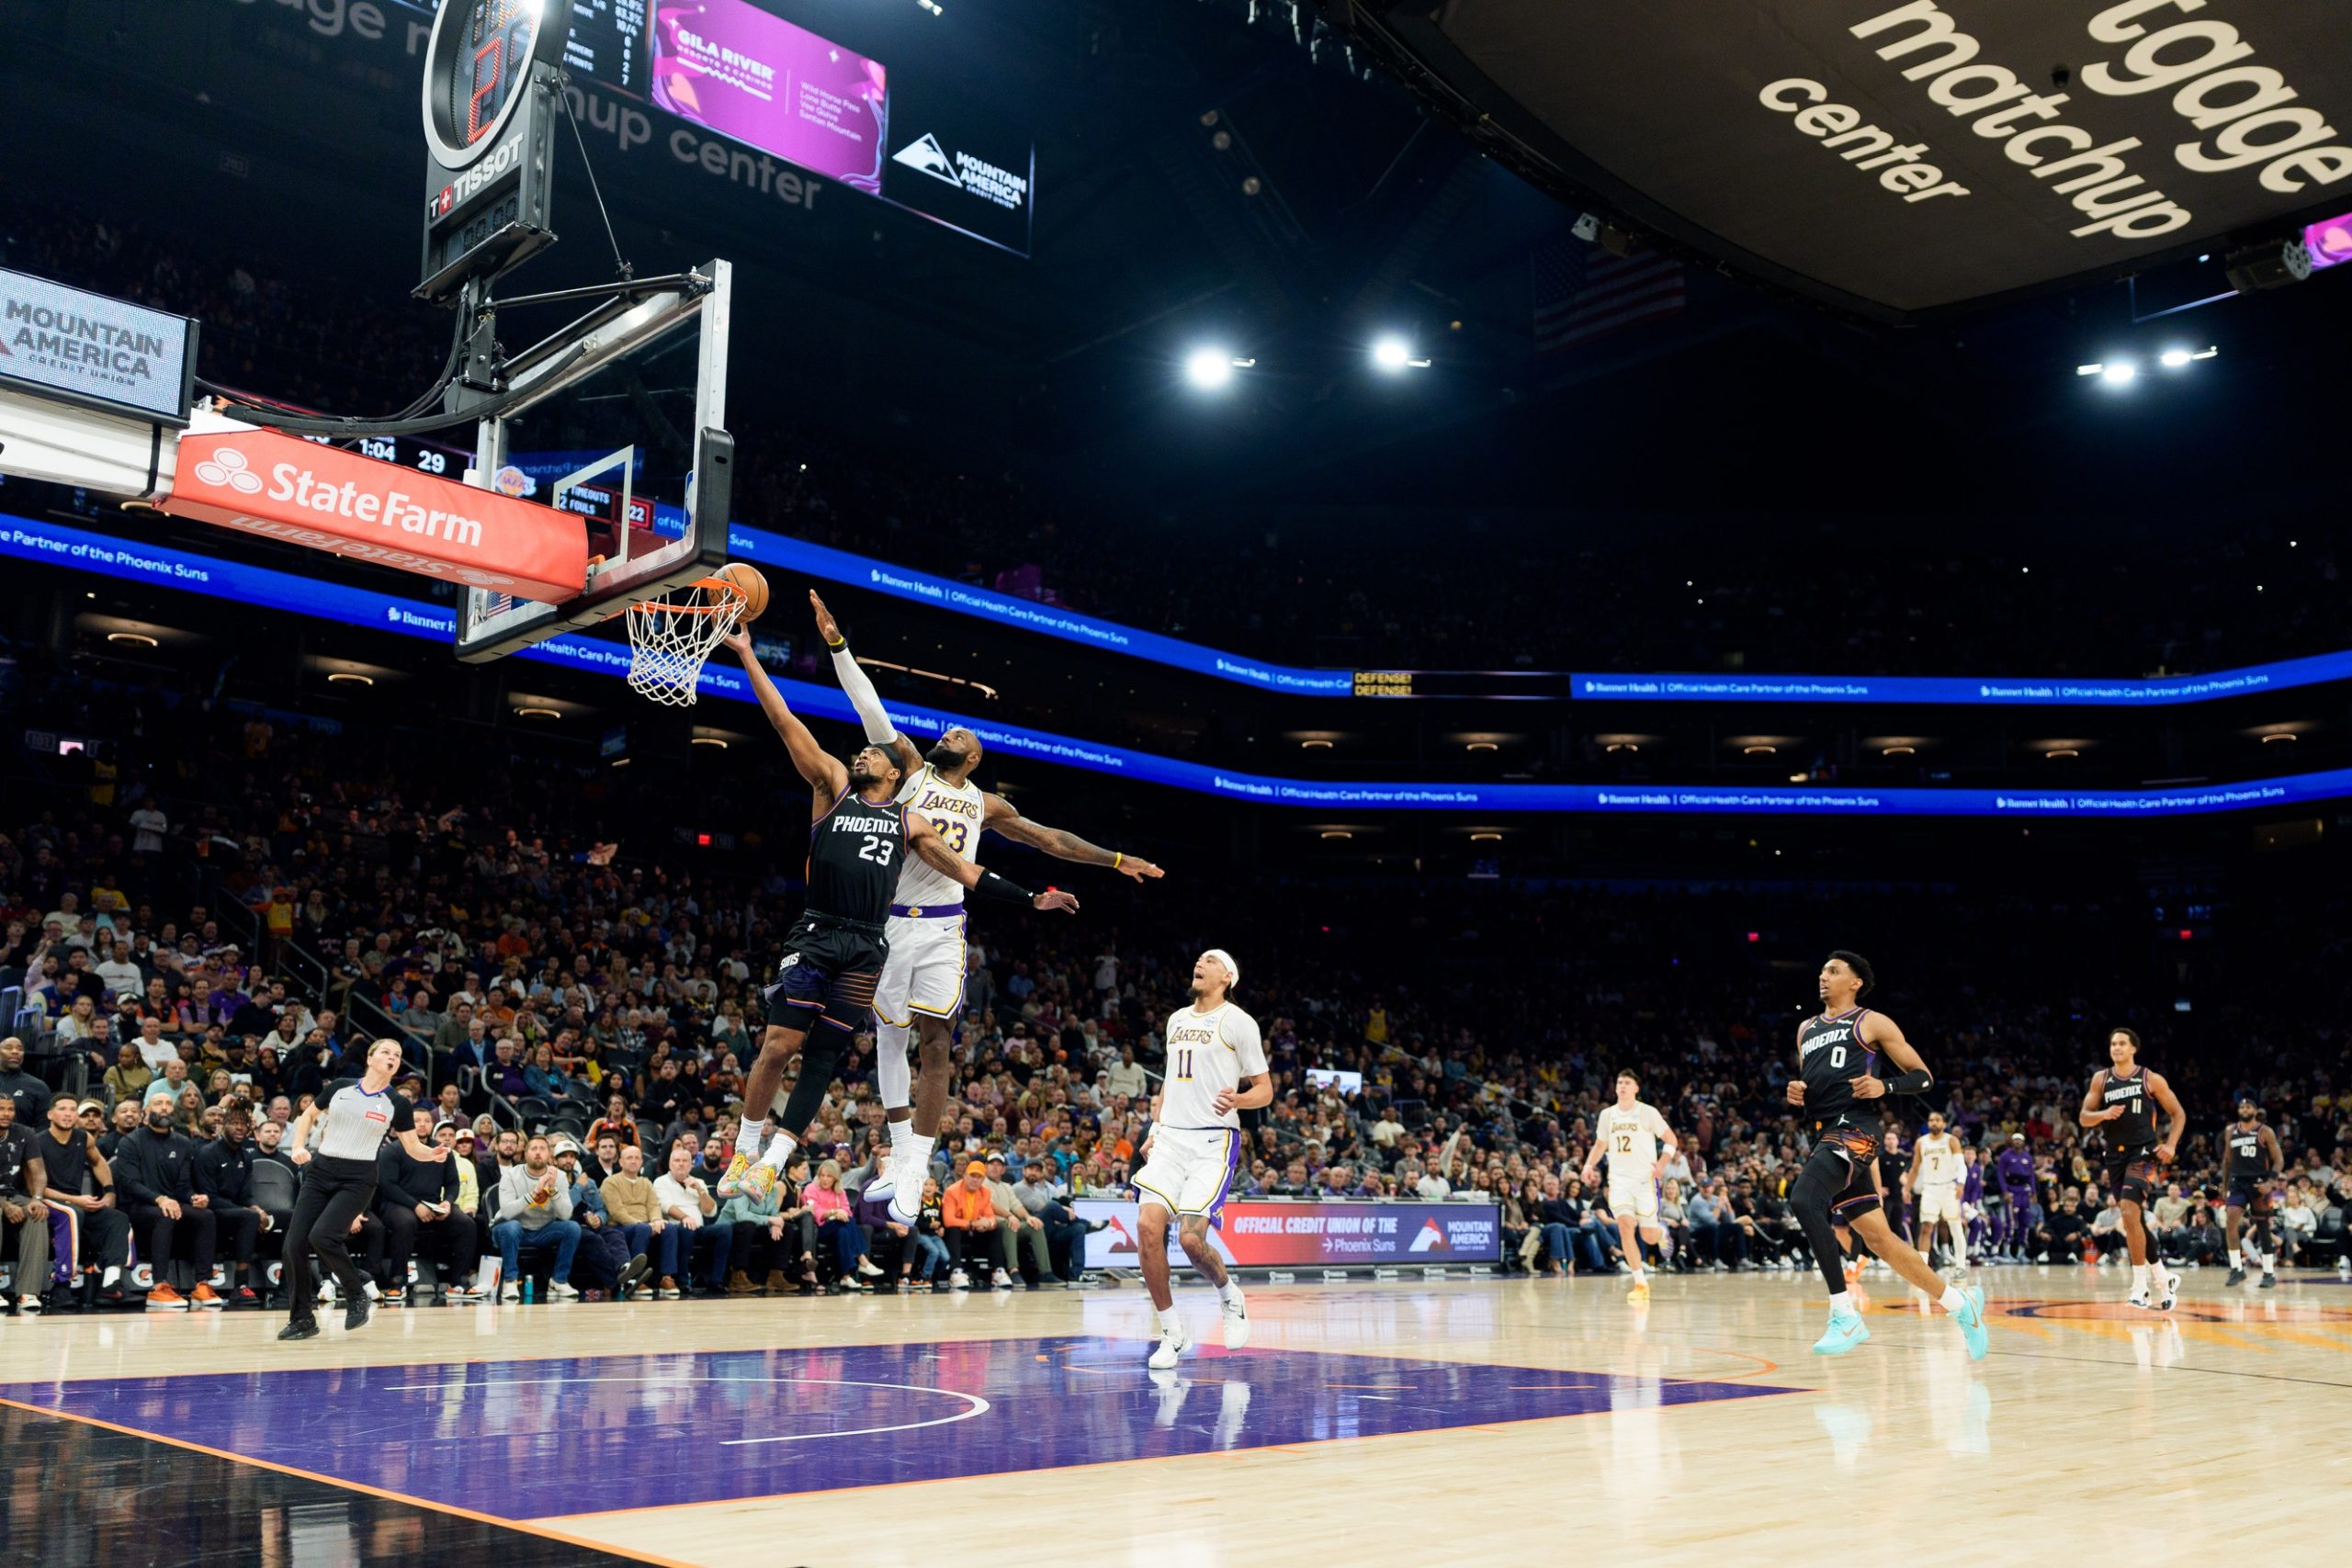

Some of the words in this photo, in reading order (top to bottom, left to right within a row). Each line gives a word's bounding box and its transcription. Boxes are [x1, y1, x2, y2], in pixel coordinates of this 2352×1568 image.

[677, 29, 721, 59] GILA
[721, 48, 774, 81] RIVER
[623, 62, 630, 73] 2
[1848, 0, 2194, 239] matchup
[1758, 76, 1972, 204] center
[453, 132, 524, 202] TISSOT
[669, 129, 822, 211] center
[956, 151, 1027, 194] MOUNTAIN
[959, 167, 1023, 206] AMERICA
[6, 299, 164, 359] MOUNTAIN
[13, 325, 153, 380] AMERICA
[28, 354, 85, 374] CREDIT
[89, 369, 136, 387] UNION
[358, 439, 396, 462] 1:04
[417, 450, 446, 474] 29
[266, 463, 379, 523] State
[381, 491, 483, 547] Farm
[559, 496, 567, 510] 2
[569, 499, 596, 515] FOULS
[571, 485, 610, 505] TIMEOUTS
[729, 534, 754, 550] Suns
[13, 530, 69, 553] Partner
[71, 544, 88, 556] of
[89, 547, 114, 562] the
[116, 551, 173, 574] Phoenix
[175, 562, 209, 581] Suns
[402, 611, 447, 632] Banner
[914, 581, 943, 597] Health
[1010, 605, 1027, 619] Care
[1111, 632, 1128, 644] Suns
[539, 639, 578, 658] Health
[578, 646, 604, 662] Care
[717, 673, 741, 690] Suns
[917, 790, 978, 819] LAKERS
[831, 815, 899, 836] PHOENIX
[858, 834, 894, 866] 23
[1169, 1026, 1215, 1045] LAKERS
[1176, 1049, 1193, 1081] 11
[1830, 1045, 1847, 1068] 0
[2104, 1084, 2143, 1104] PHOENIX
[2132, 1099, 2142, 1113] 11
[1616, 1135, 1632, 1153] 12
[2240, 1145, 2257, 1157] 00
[1931, 1156, 1939, 1170] 7
[1234, 1217, 1283, 1234] OFFICIAL
[1285, 1217, 1326, 1234] CREDIT
[1327, 1217, 1362, 1234] UNION
[1362, 1217, 1376, 1234] OF
[1377, 1217, 1398, 1234] THE
[1335, 1238, 1373, 1253] Phoenix
[1373, 1238, 1396, 1252] Suns
[1450, 1233, 1490, 1245] AMERICA
